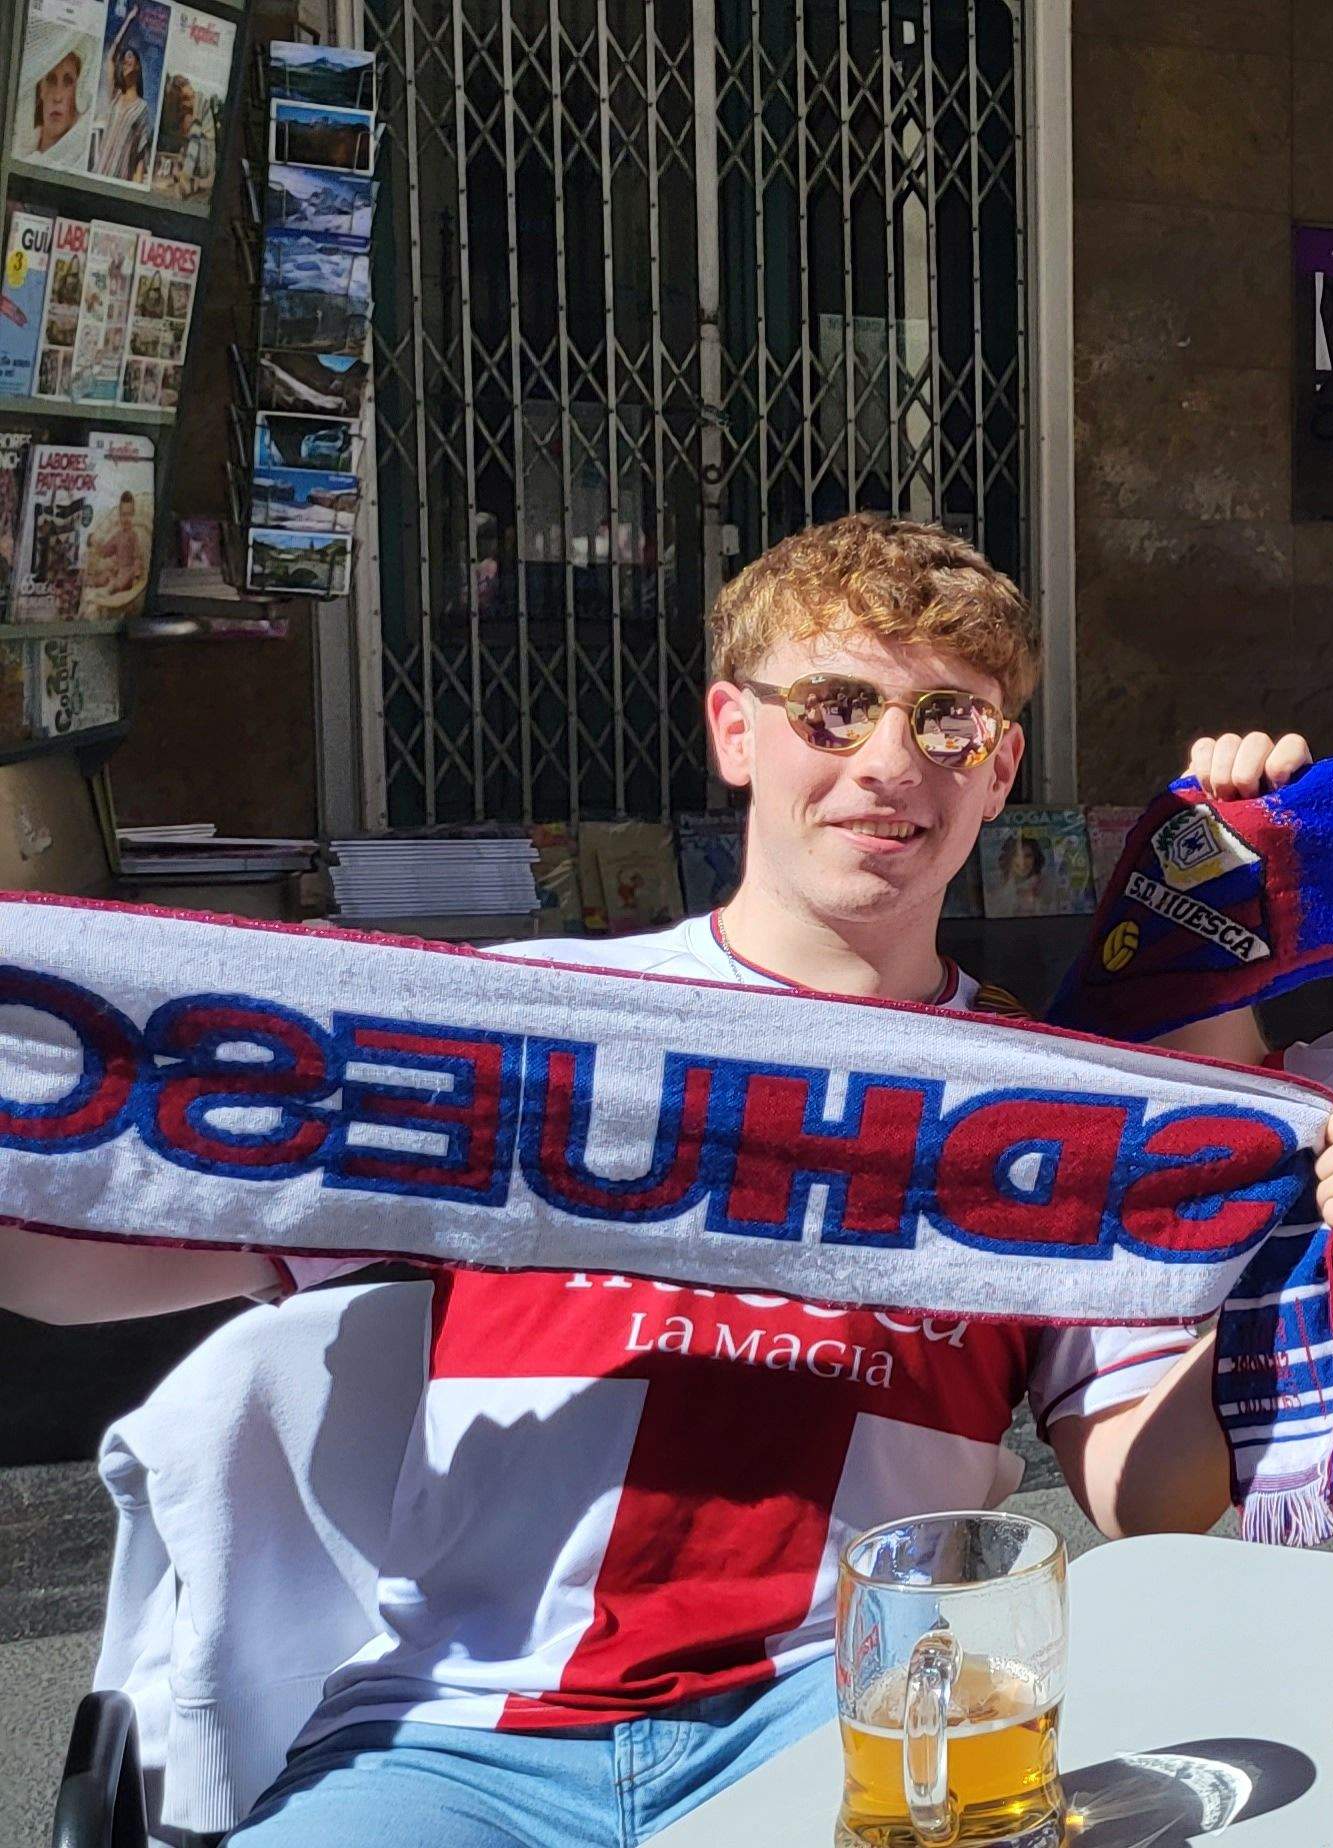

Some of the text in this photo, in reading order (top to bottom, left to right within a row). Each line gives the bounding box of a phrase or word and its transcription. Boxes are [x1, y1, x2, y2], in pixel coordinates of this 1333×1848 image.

[140, 239, 197, 274] LABORES
[38, 452, 88, 471] LABORES
[1155, 890, 1255, 959] HUESCA
